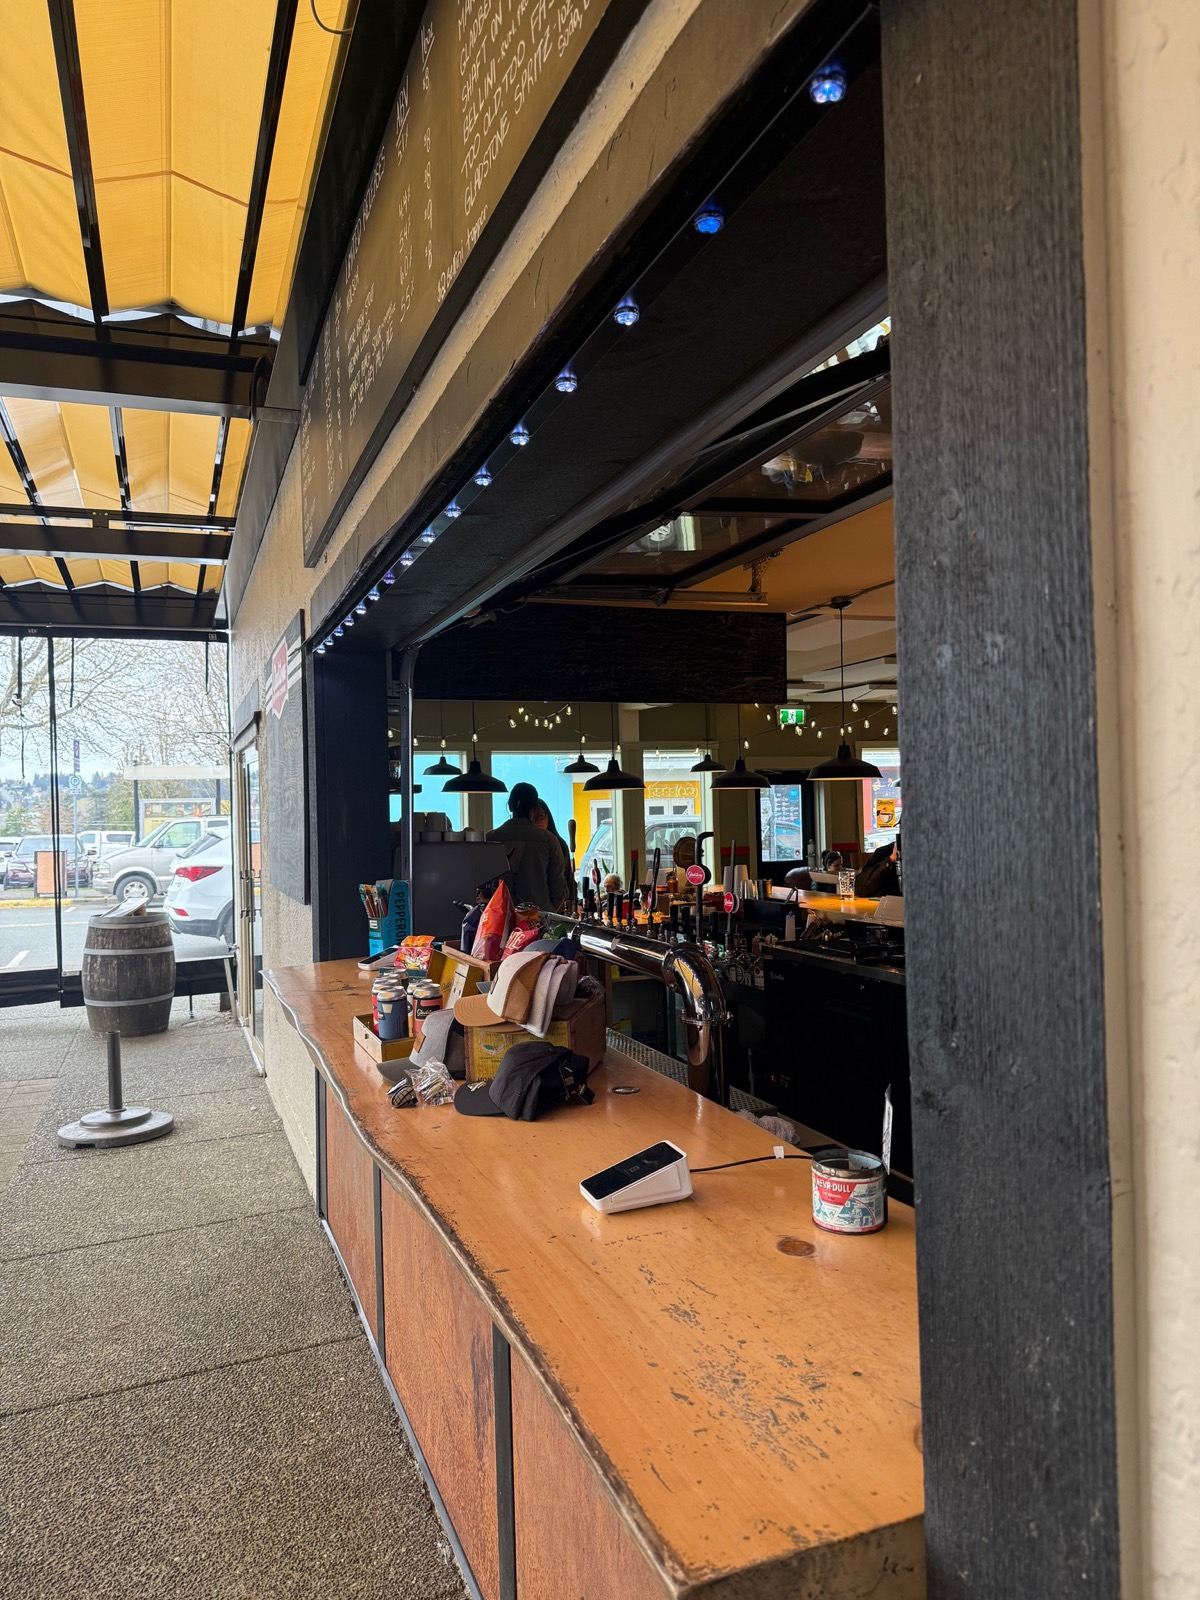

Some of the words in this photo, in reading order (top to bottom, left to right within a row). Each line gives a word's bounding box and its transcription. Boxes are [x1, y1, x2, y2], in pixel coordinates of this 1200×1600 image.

[397, 74, 408, 135] ABV
[461, 35, 487, 113] SHAFT
[463, 58, 497, 146] BELLINI
[460, 132, 480, 179] TOO
[502, 40, 526, 93] TOO
[464, 110, 511, 217] GLADSTONE
[514, 25, 554, 115] SPRITZ
[363, 145, 386, 231] RELEASES
[424, 161, 432, 190] $8
[424, 199, 433, 230] $9
[424, 239, 433, 271] $8
[394, 891, 408, 946] PEPPERO
